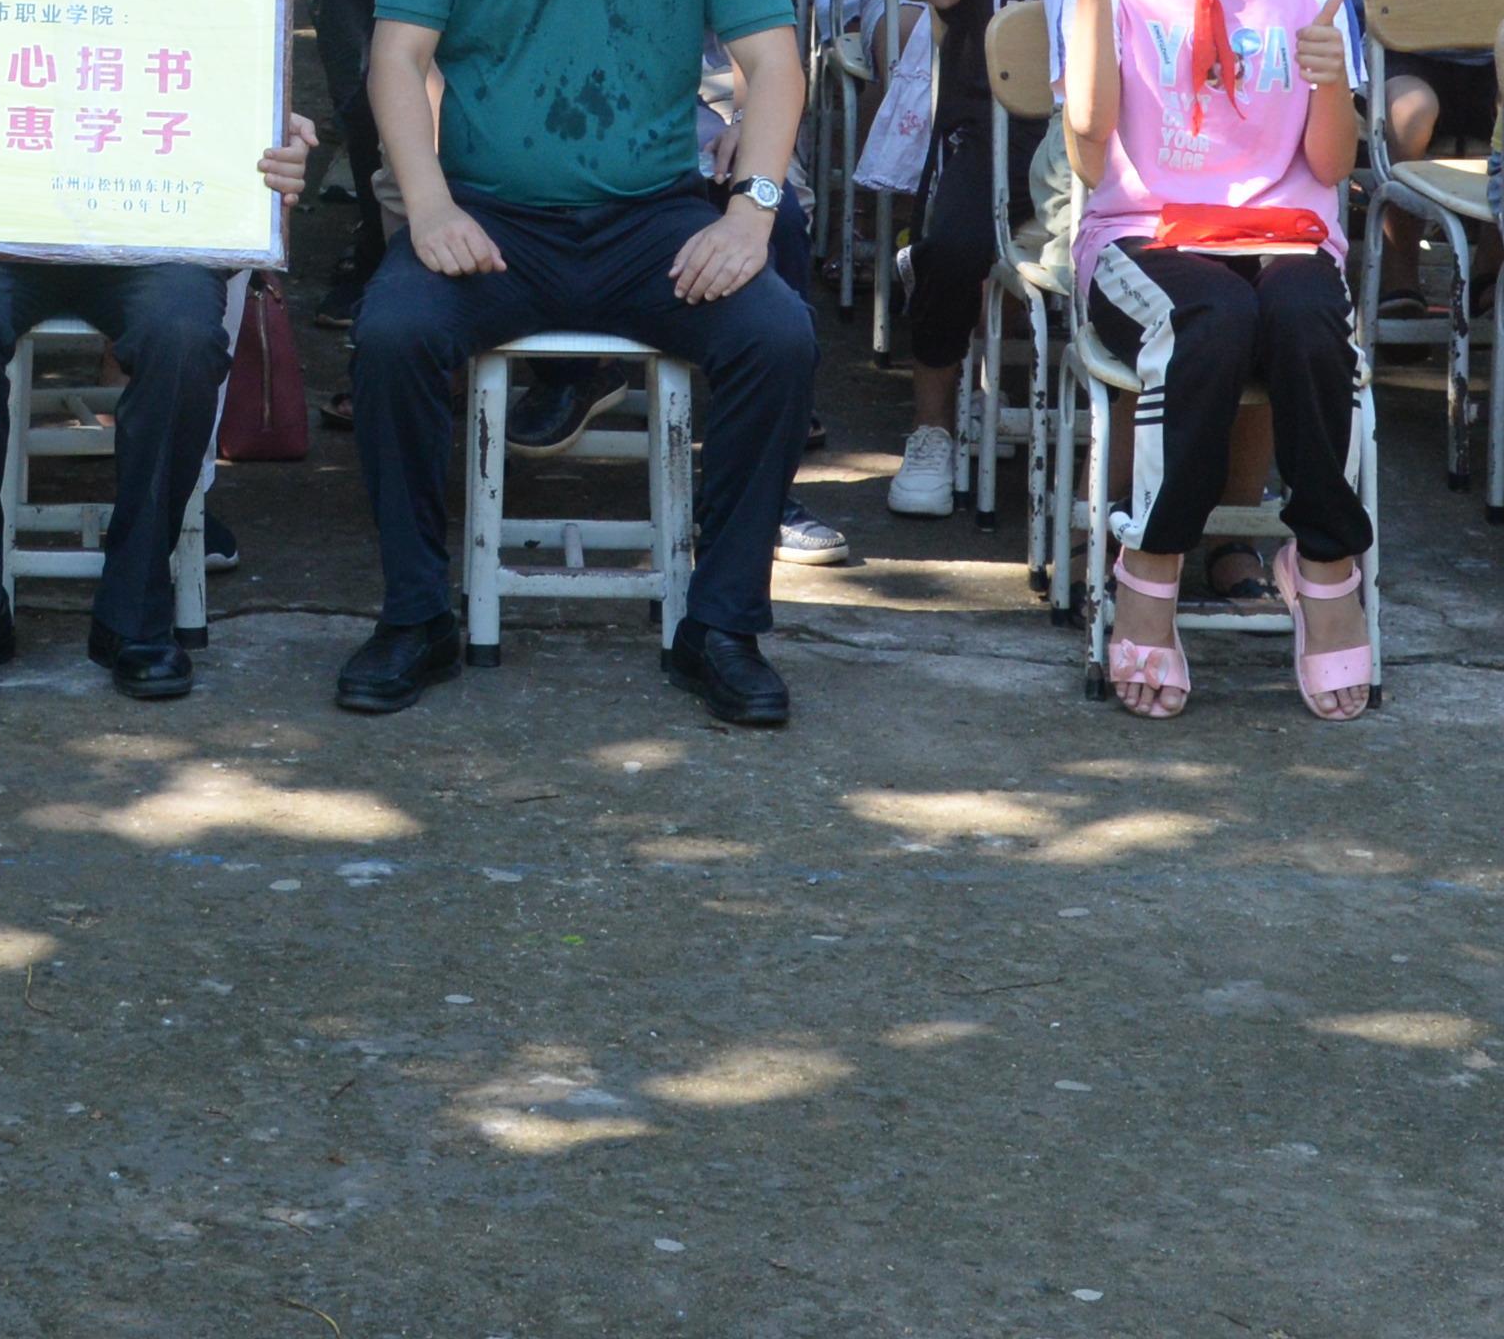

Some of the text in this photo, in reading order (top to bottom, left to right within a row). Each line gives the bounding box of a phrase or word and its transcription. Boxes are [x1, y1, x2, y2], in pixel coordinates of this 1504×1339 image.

[51, 176, 205, 195] 雷州市松竹镇东井小学
